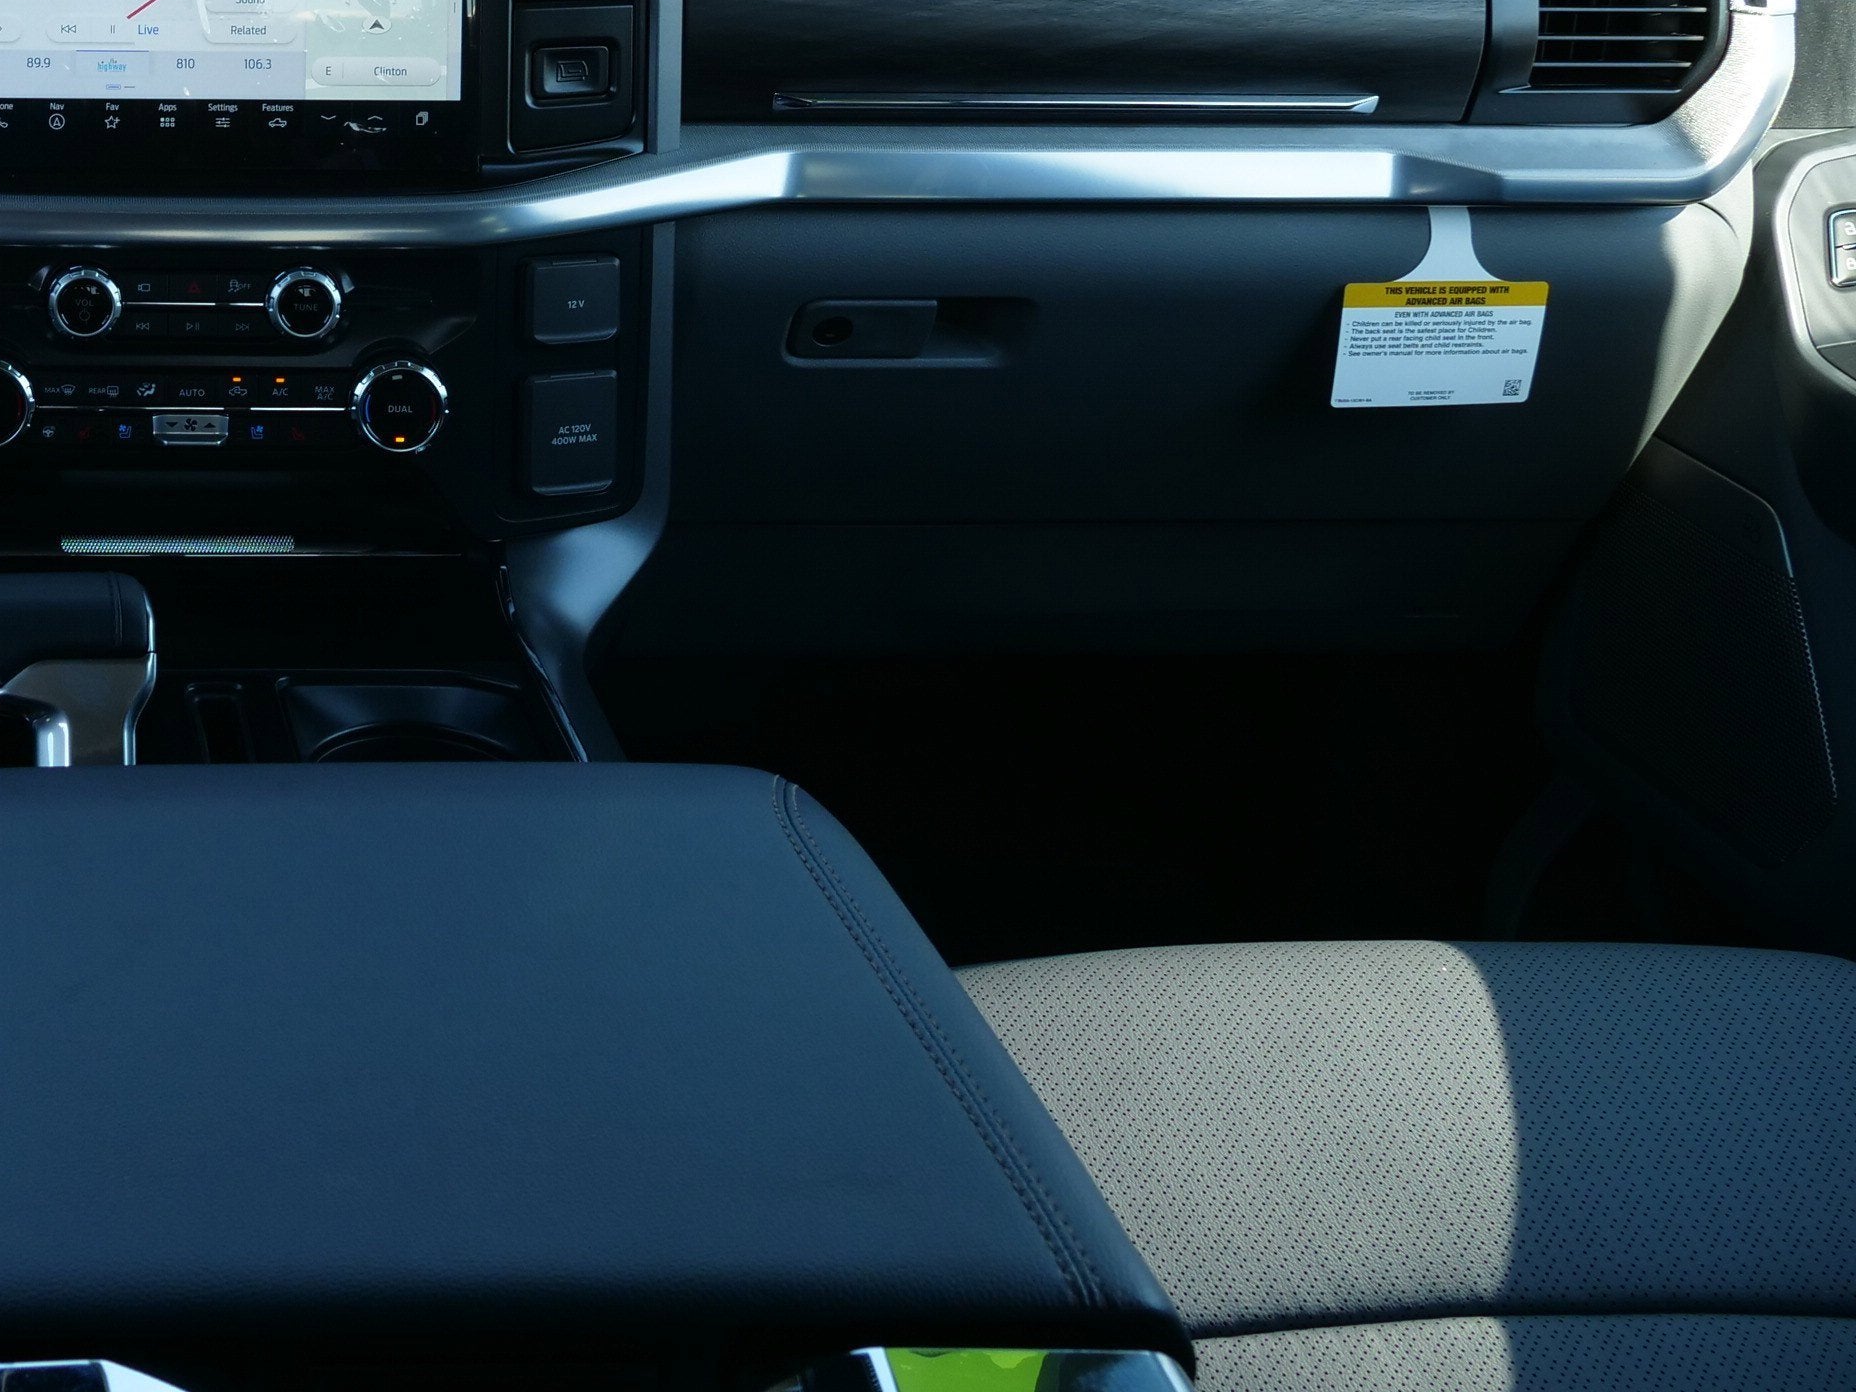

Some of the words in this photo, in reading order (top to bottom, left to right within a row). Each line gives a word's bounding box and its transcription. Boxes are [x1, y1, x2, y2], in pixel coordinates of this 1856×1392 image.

[137, 24, 159, 36] Live
[230, 25, 267, 36] Related
[26, 57, 51, 68] 89.9
[97, 61, 127, 73] highway
[176, 58, 195, 69] 810
[244, 59, 272, 70] 106.3
[325, 67, 332, 77] E
[373, 66, 408, 77] Clinton
[50, 102, 64, 111] Nav
[105, 102, 120, 111] Fav
[158, 103, 177, 113] Apps
[207, 103, 238, 113] Settings
[262, 103, 294, 112] Features
[237, 282, 253, 291] OFF
[1385, 286, 1403, 295] THIS
[1405, 286, 1437, 295] VEHICLE
[1439, 286, 1447, 295] IS
[1449, 286, 1487, 295] EQUIPPED
[1489, 285, 1510, 294] WITH
[75, 297, 95, 308] VOL
[1405, 297, 1447, 306] ADVANCED
[1449, 297, 1463, 305] AIR
[1465, 297, 1486, 305] BAGS
[293, 302, 320, 313] TUNE
[1430, 310, 1463, 318] ADVANCED
[44, 386, 61, 395] MAX
[88, 387, 107, 395] REAR
[178, 388, 206, 398] AUTO
[271, 387, 289, 398] A/C
[314, 385, 335, 394] MAX
[316, 393, 334, 401] A/C
[387, 404, 413, 415] DUAL
[558, 425, 571, 435] AC
[571, 423, 592, 434] 120V
[551, 435, 577, 446] 400W
[578, 433, 598, 444] MAX
